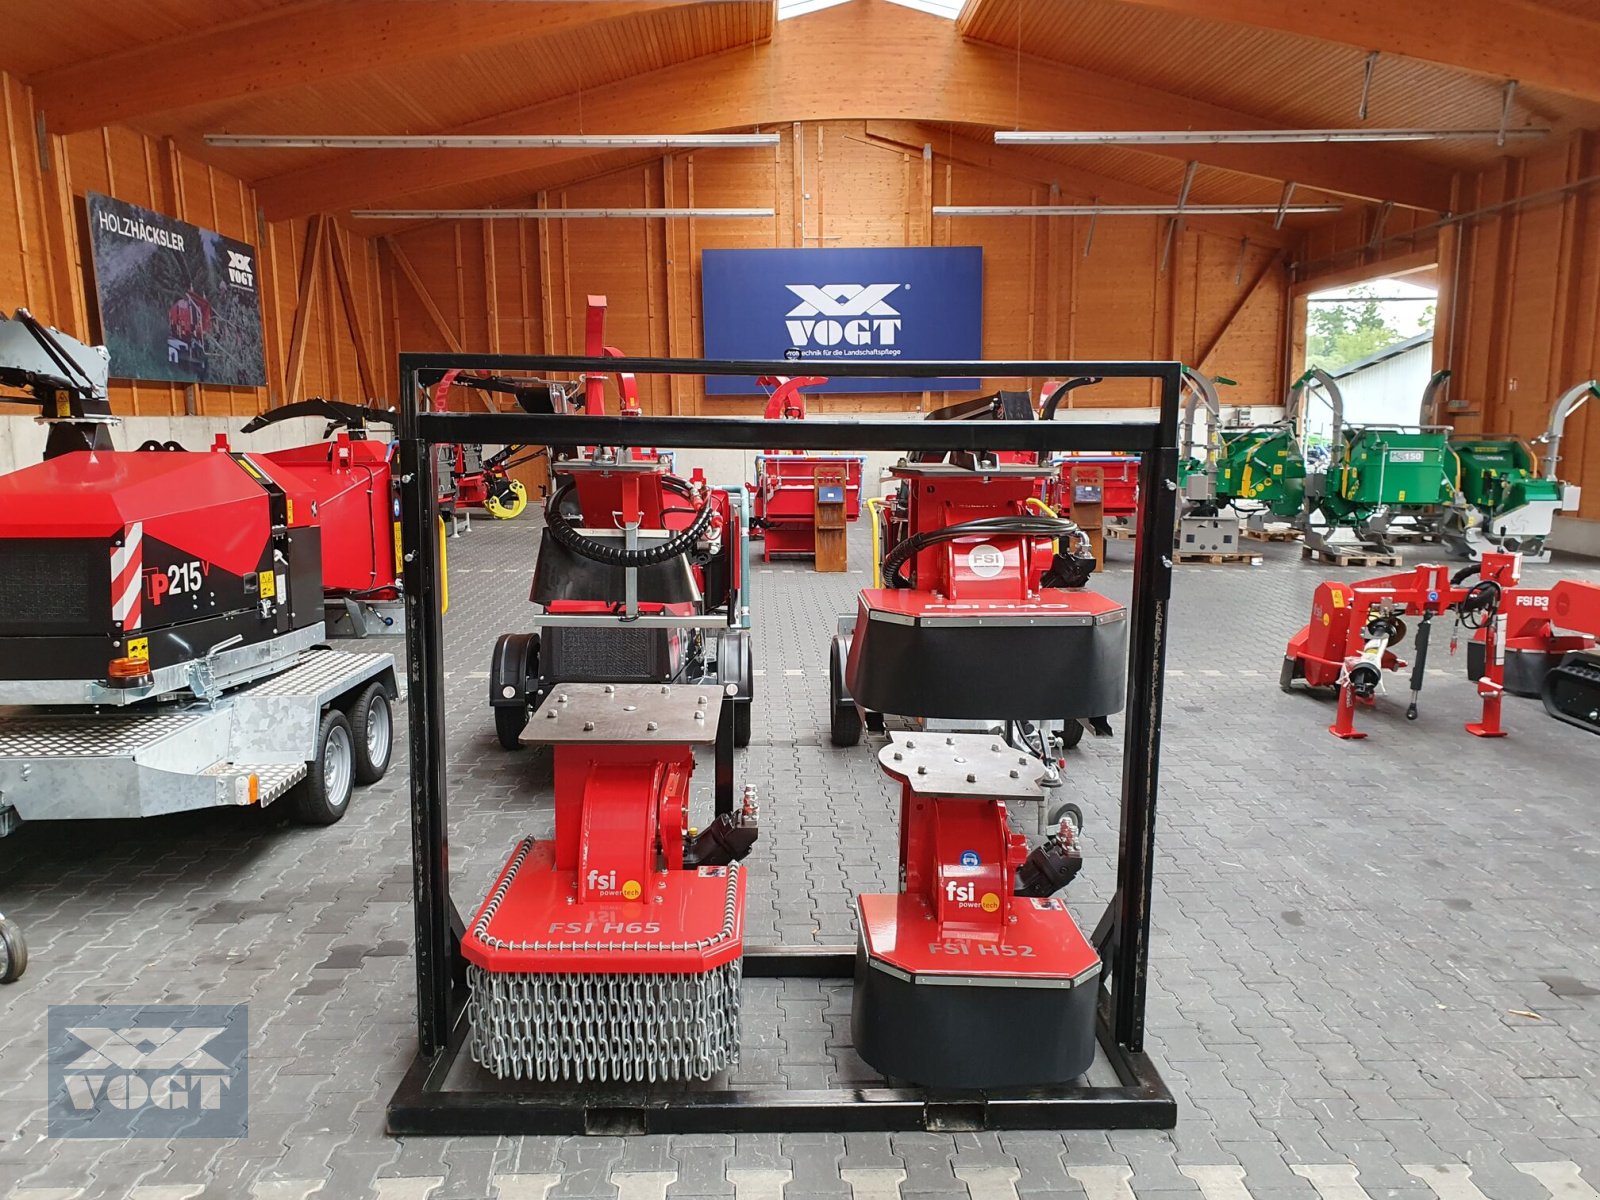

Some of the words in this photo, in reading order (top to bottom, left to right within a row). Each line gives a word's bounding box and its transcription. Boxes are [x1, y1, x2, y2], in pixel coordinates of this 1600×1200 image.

[99, 210, 185, 252] HOLZHÄCKSLER
[228, 268, 253, 287] VOGT
[785, 319, 901, 346] VOGT
[844, 348, 901, 357] Landschaftspflege
[973, 554, 1000, 564] FSI
[1516, 595, 1533, 607] FSI
[1533, 596, 1549, 607] B3
[587, 870, 616, 890] fsi
[946, 881, 975, 902] fsi
[548, 922, 593, 934] FSI
[603, 922, 661, 934] H65
[928, 943, 969, 955] FSI
[978, 944, 1037, 957] H52
